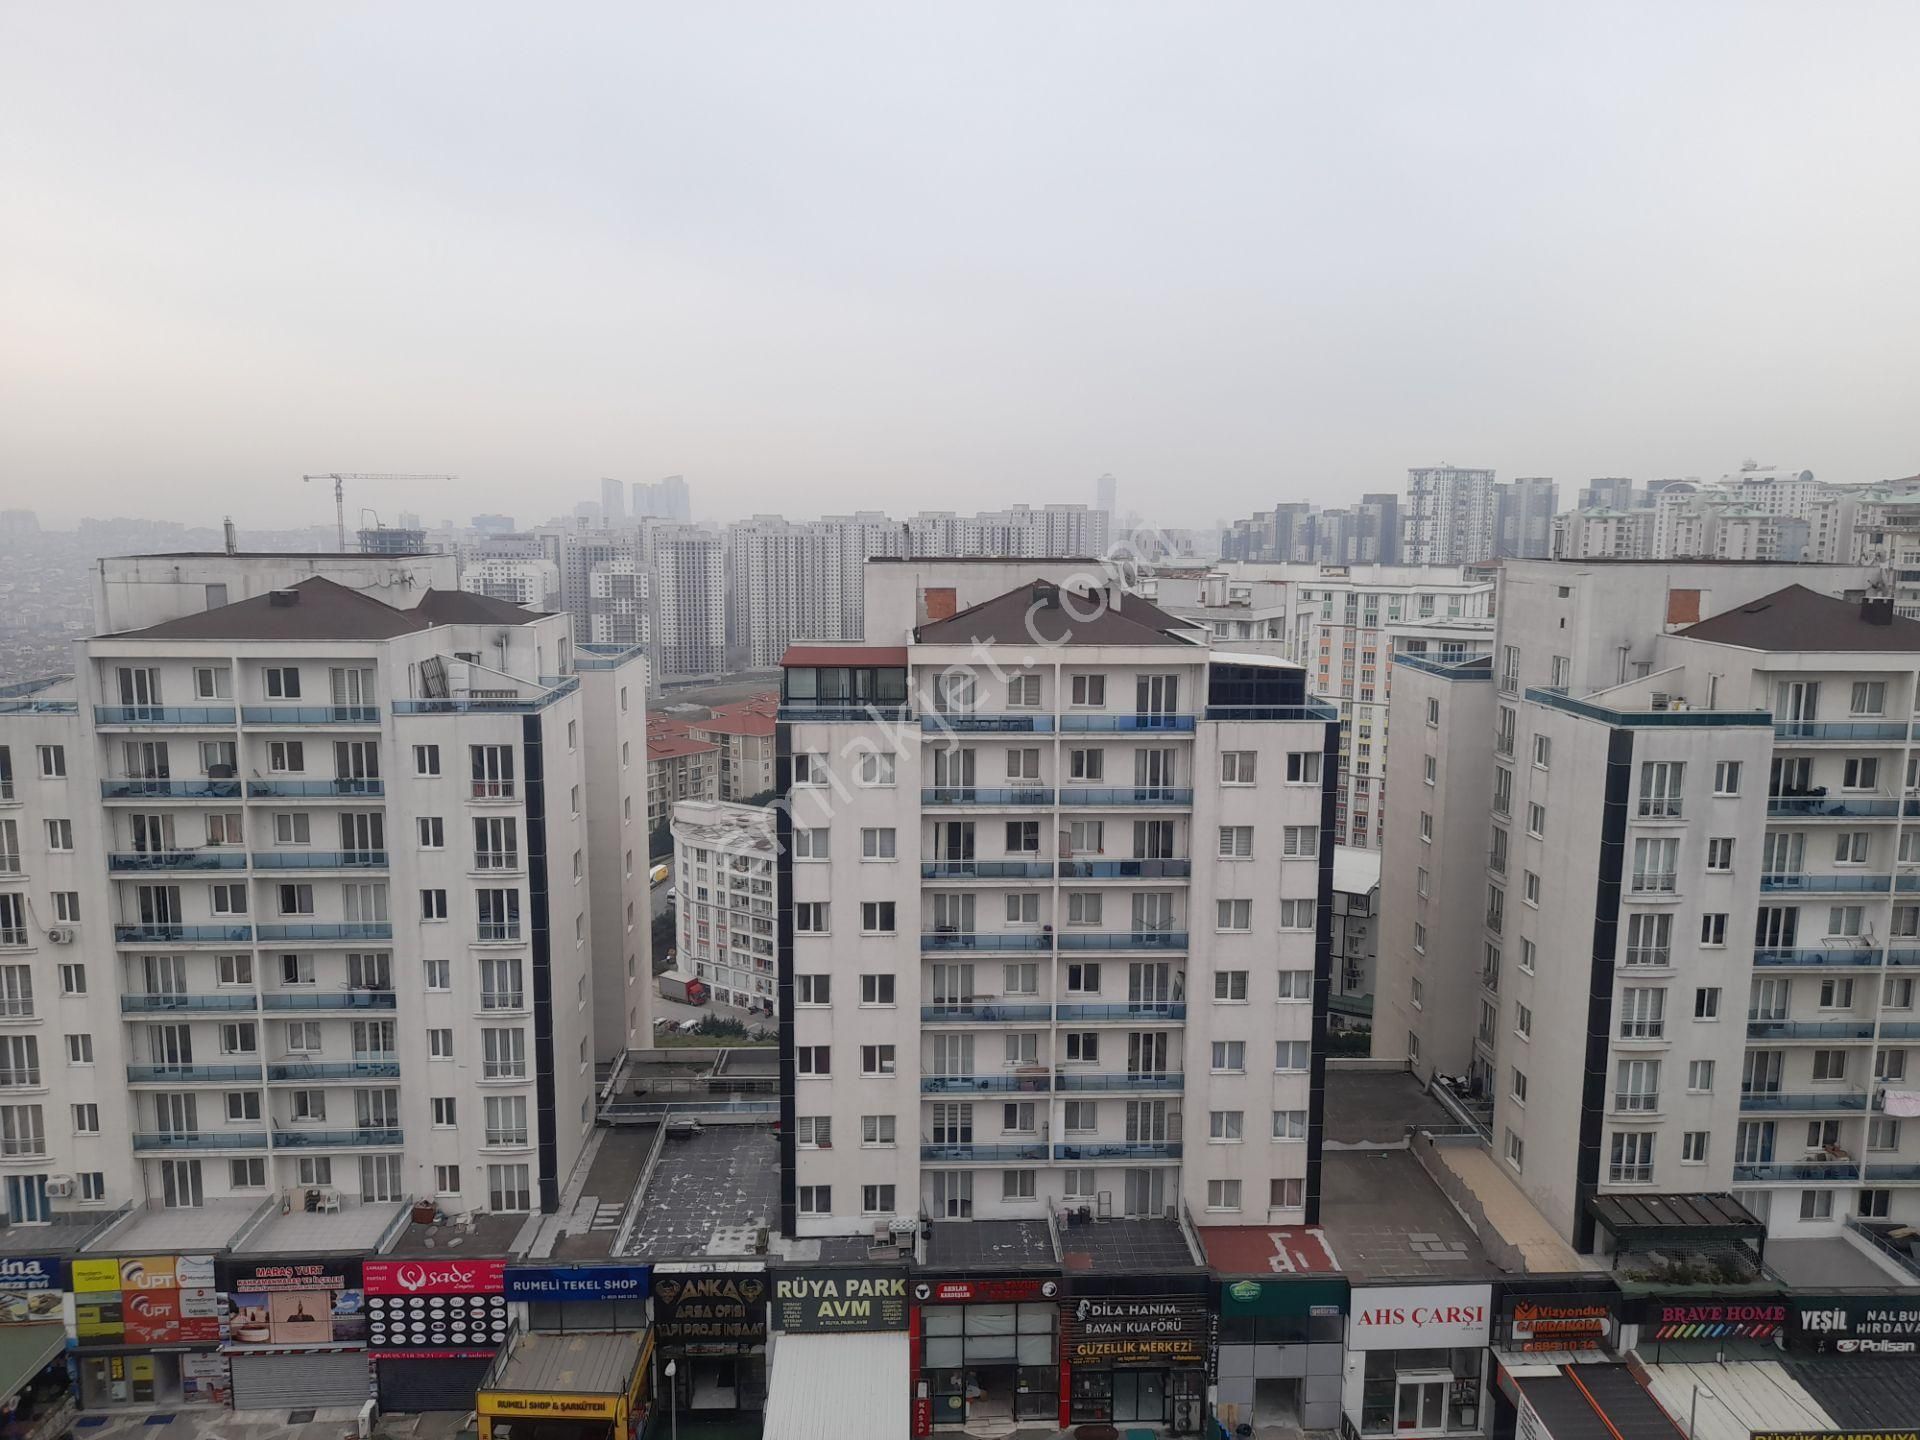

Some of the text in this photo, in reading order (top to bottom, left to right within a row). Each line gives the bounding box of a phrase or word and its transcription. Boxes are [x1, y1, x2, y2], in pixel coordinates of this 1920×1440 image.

[256, 1265, 324, 1279] MARAŞ YURT
[428, 1263, 473, 1286] sade
[137, 1275, 174, 1289] UPT
[513, 1279, 560, 1291] RUMELİ
[562, 1280, 601, 1290] TEKEL
[604, 1279, 638, 1289] SHOP
[777, 1276, 907, 1298] RÜYA PARK
[676, 1279, 744, 1304] ANKA
[142, 1305, 172, 1317] UPT
[675, 1304, 713, 1318] ARSA
[817, 1300, 871, 1317] AVM
[1092, 1302, 1176, 1316] DİLA HANIM
[1663, 1305, 1785, 1323] BRAVE HOME
[1358, 1306, 1483, 1328] AHS ÇARŞI
[1801, 1307, 1920, 1334] YEŞİL NALBU
[683, 1322, 722, 1337] PROJE
[1086, 1318, 1182, 1334] BAYAN KUAFÖRÜ
[1077, 1339, 1193, 1356] GÜZELLİK MERKEZİ
[1860, 1340, 1915, 1352] Polisan
[497, 1399, 527, 1409] RUMELİ
[529, 1401, 551, 1410] SHOP
[561, 1400, 606, 1412] ŞARKÜTERİ
[917, 1402, 926, 1434] KASAP
